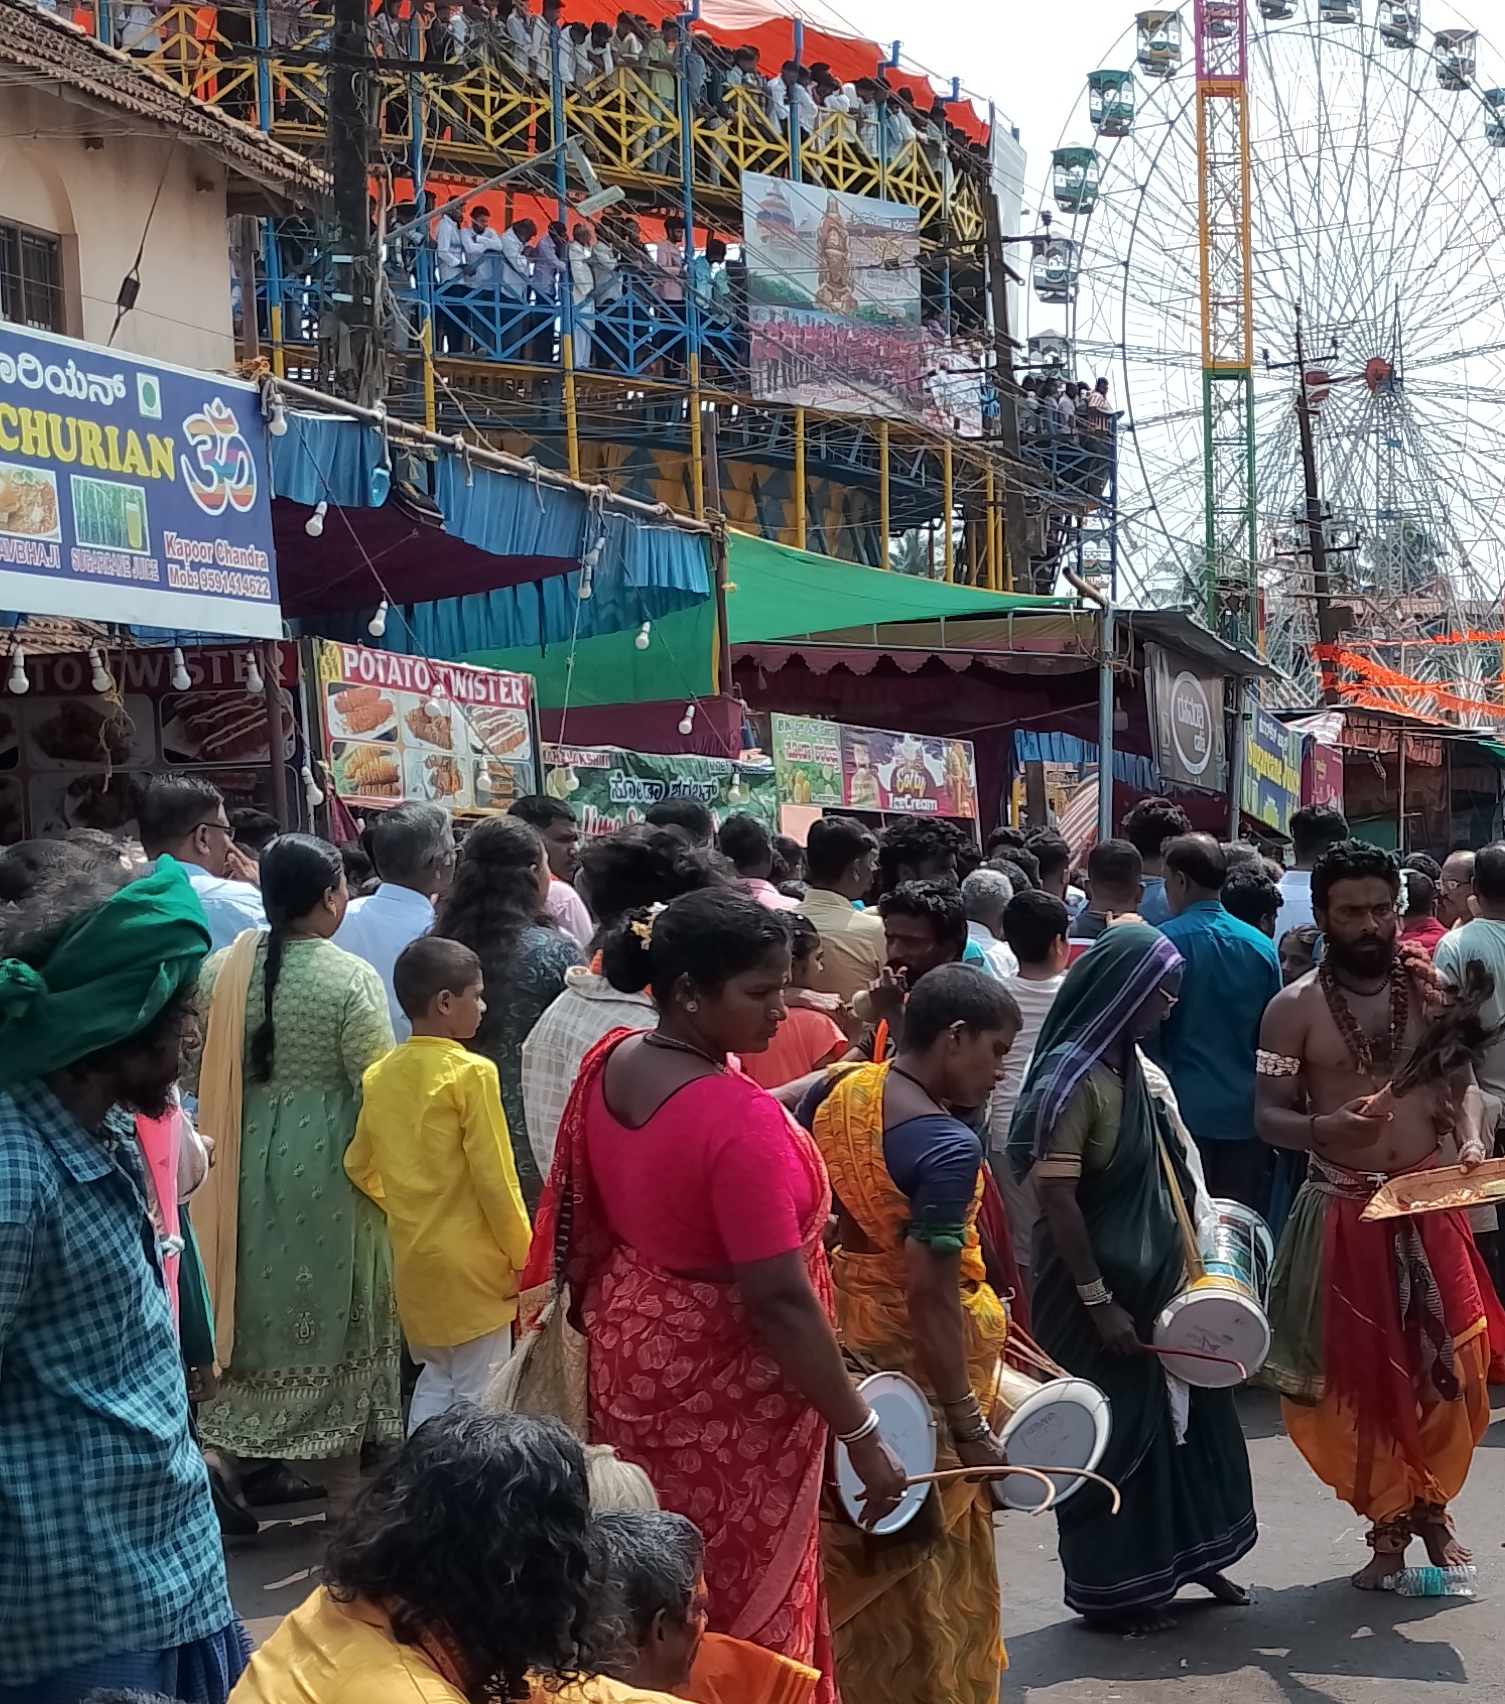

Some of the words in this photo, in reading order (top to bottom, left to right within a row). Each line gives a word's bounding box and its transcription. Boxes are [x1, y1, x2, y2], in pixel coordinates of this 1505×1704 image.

[71, 546, 132, 579] SUGARCANE
[132, 557, 160, 583] JUICE
[163, 530, 214, 566] Kapoor
[214, 538, 269, 572] Chandra
[167, 564, 200, 588] Mob:
[341, 646, 431, 692] POTATO
[432, 665, 526, 706] TWISTER
